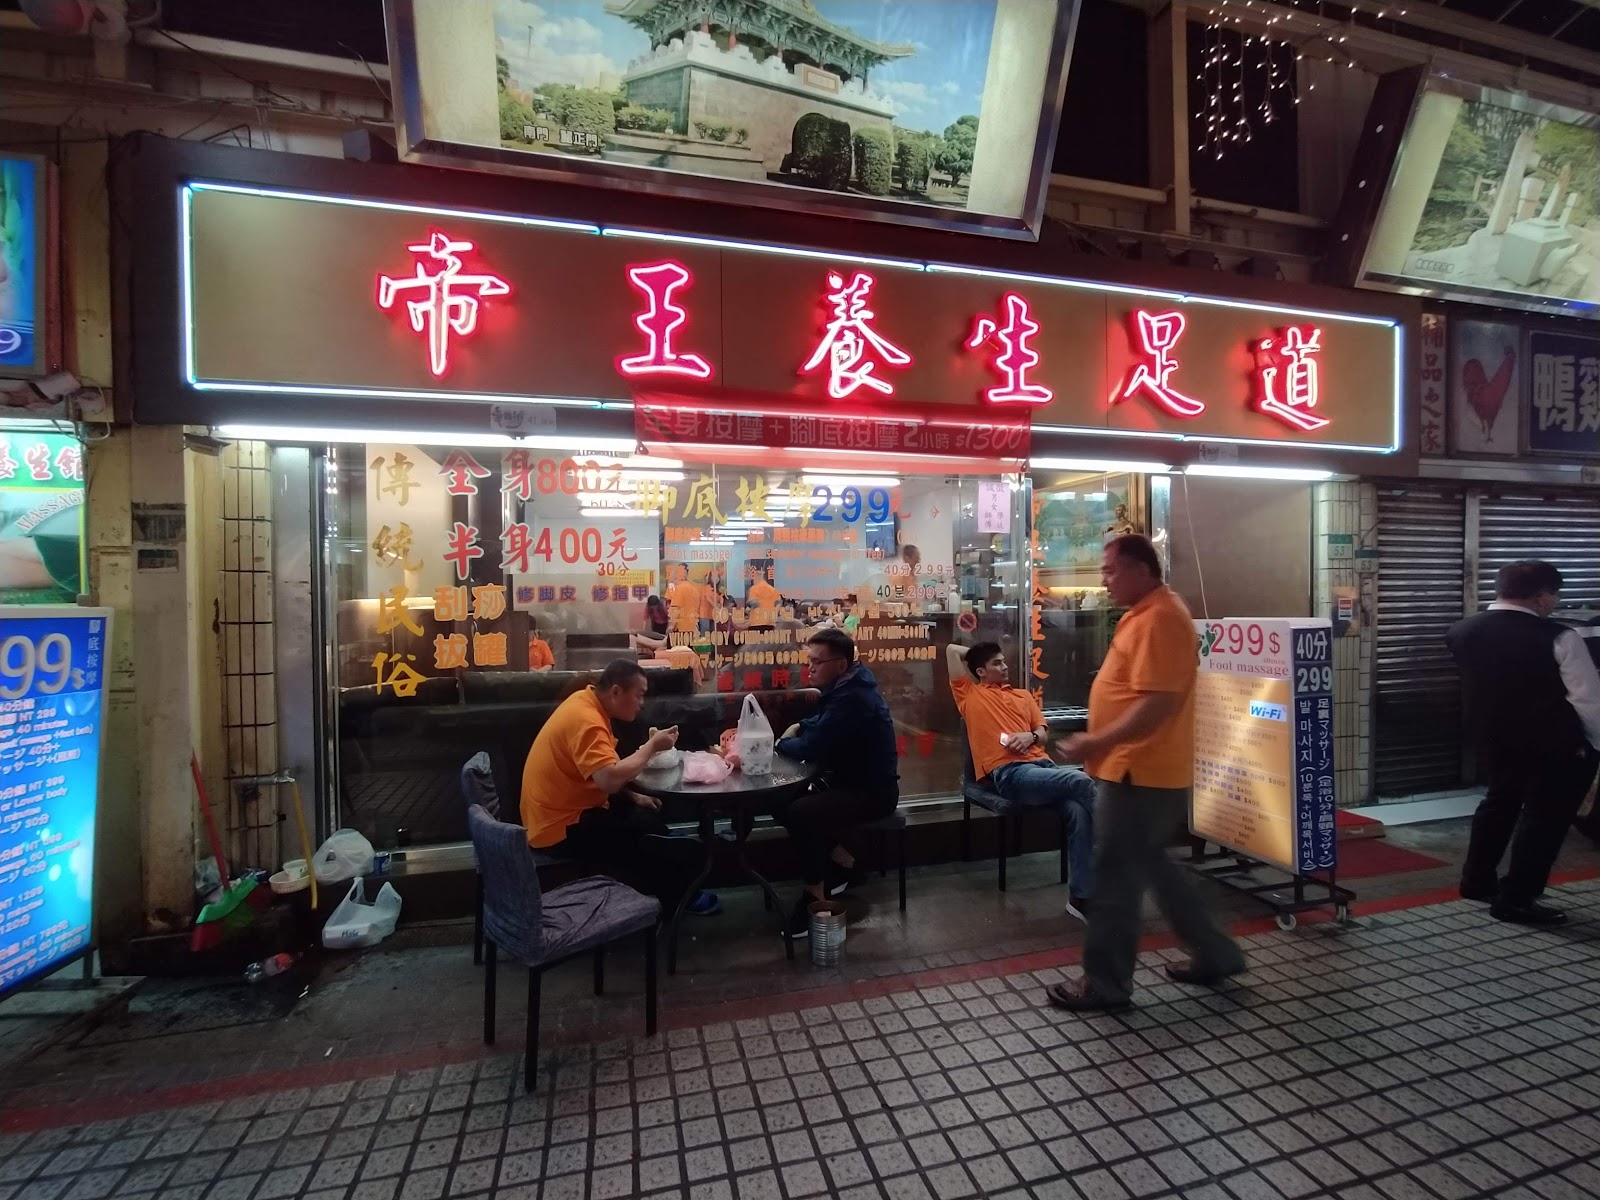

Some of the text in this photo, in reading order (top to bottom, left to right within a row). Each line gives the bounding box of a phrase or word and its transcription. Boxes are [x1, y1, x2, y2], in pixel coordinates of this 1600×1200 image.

[523, 125, 549, 141] 南門
[377, 231, 1331, 430] 帝王養生足道
[17, 488, 86, 533] MASSAG
[1210, 623, 1264, 655] 299
[1297, 631, 1328, 660] 40分
[1209, 659, 1289, 676] Foot massage
[1297, 666, 1333, 692] 299
[1250, 705, 1282, 720] Wi-Fi
